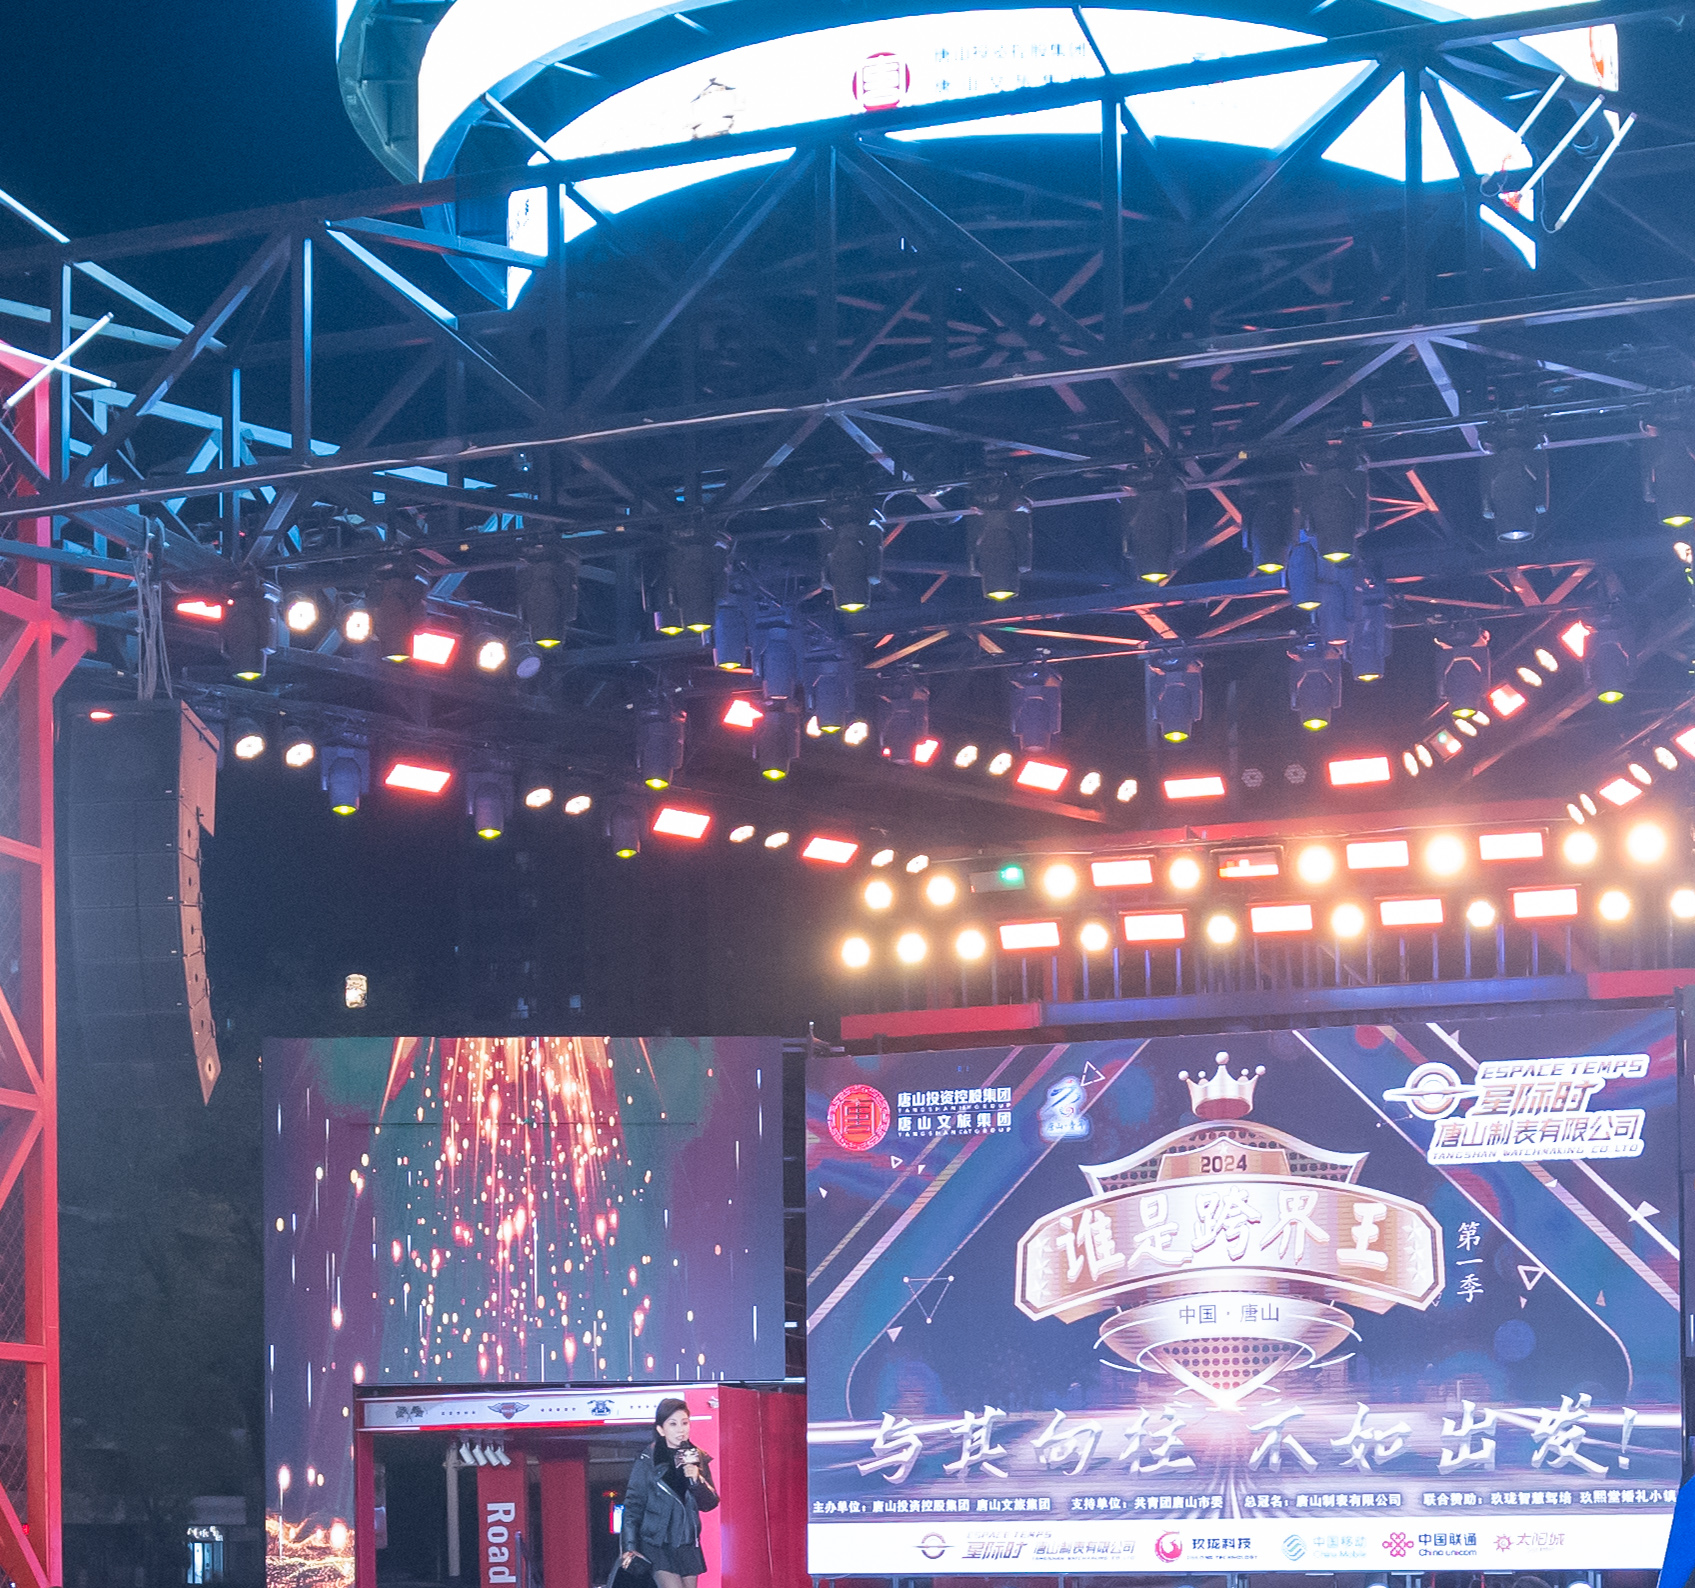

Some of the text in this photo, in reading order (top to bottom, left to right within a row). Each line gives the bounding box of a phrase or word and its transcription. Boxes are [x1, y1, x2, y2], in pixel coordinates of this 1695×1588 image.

[1481, 1058, 1644, 1080] ESPACE TEMPS
[897, 1087, 1012, 1108] 唐山投资控股集团
[1471, 1080, 1599, 1117] 星际时
[897, 1111, 1012, 1132] 唐山文旅集团
[1435, 1114, 1640, 1148] 唐山制表有限公司
[1200, 1155, 1248, 1174] 2024
[1056, 1185, 1390, 1282] 谁是跨界王
[1455, 1221, 1485, 1303] 第一季
[1178, 1303, 1280, 1325] 中国·唐山
[486, 1502, 517, 1584] Road
[1191, 1538, 1251, 1550] 玖珑科技
[1418, 1533, 1477, 1546] 中国联通
